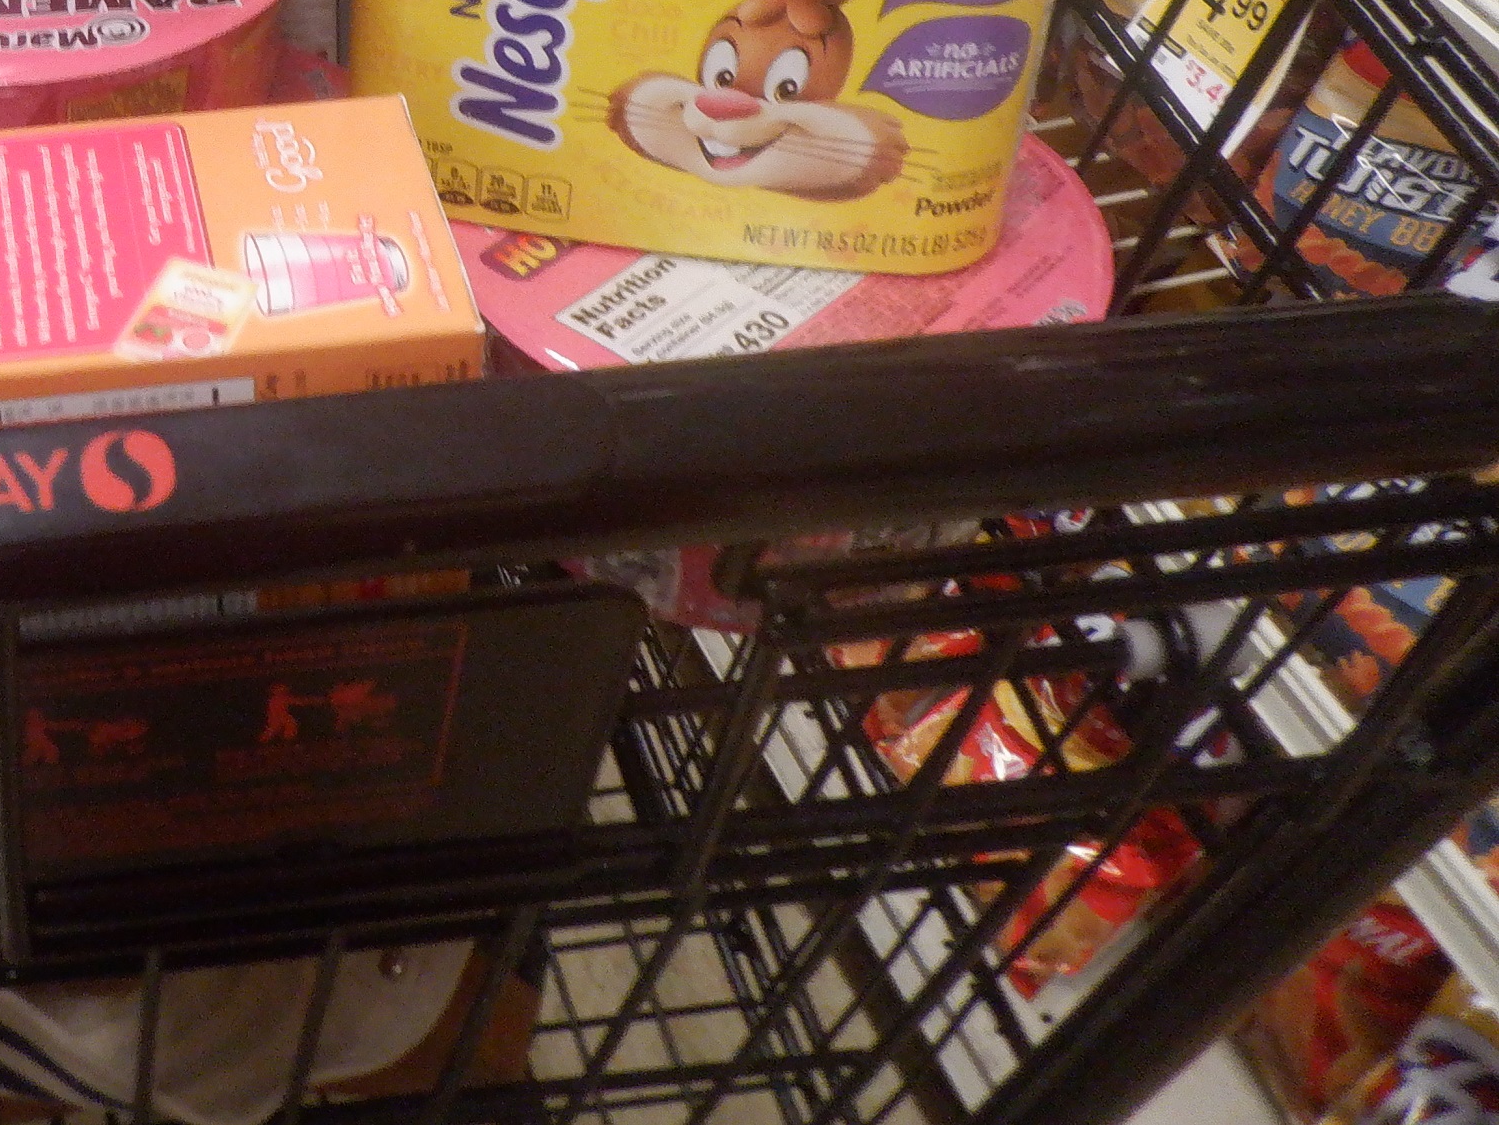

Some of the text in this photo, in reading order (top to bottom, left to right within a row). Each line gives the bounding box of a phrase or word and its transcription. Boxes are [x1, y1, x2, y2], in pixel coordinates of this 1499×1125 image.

[914, 188, 996, 218] Powder
[1287, 176, 1387, 235] HNEY
[742, 223, 779, 247] NET
[781, 225, 811, 249] WT
[569, 257, 678, 327] Nutrition
[594, 292, 669, 341] Facts
[732, 309, 791, 354] 430
